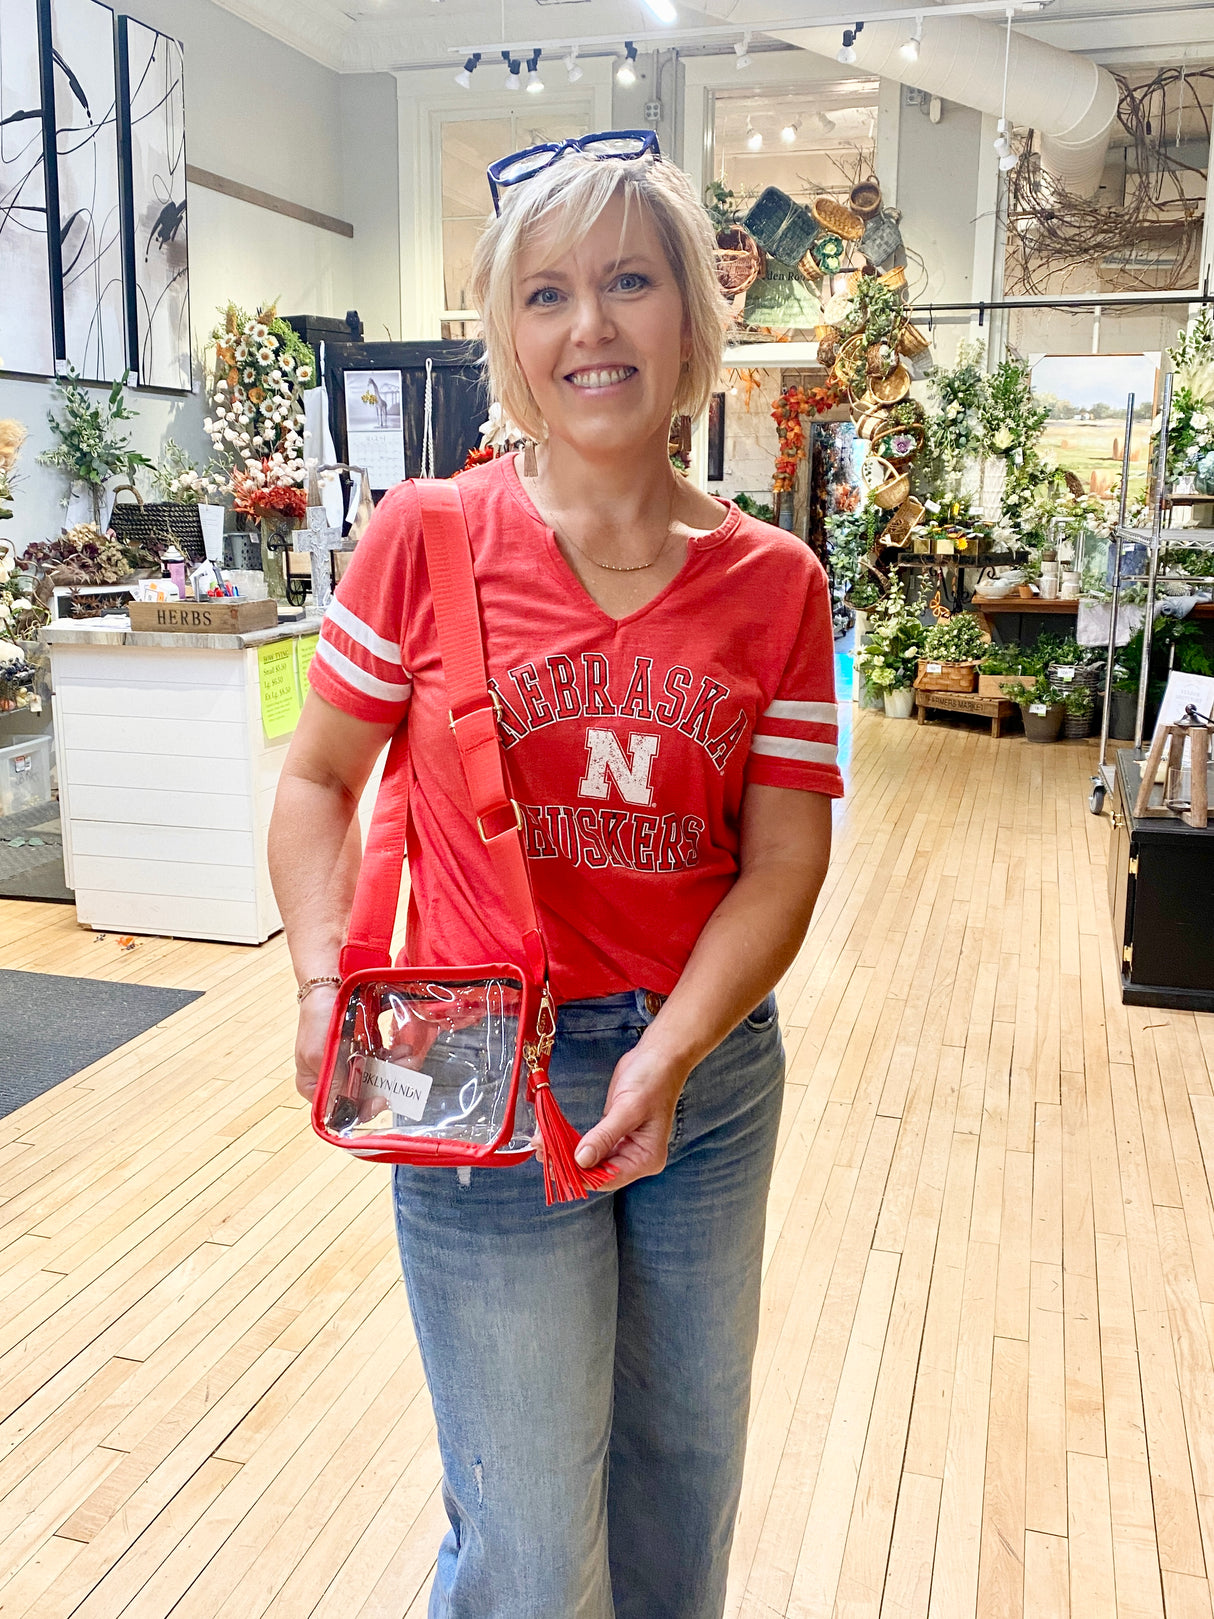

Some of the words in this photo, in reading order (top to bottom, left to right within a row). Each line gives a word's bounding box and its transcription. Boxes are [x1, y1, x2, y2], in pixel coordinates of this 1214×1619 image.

[157, 609, 212, 626] HERBS
[486, 652, 748, 771] NEBRASKA
[928, 696, 957, 708] FARMERS
[957, 700, 984, 711] MARKET
[577, 727, 661, 806] N
[517, 803, 705, 872] HUSKERS
